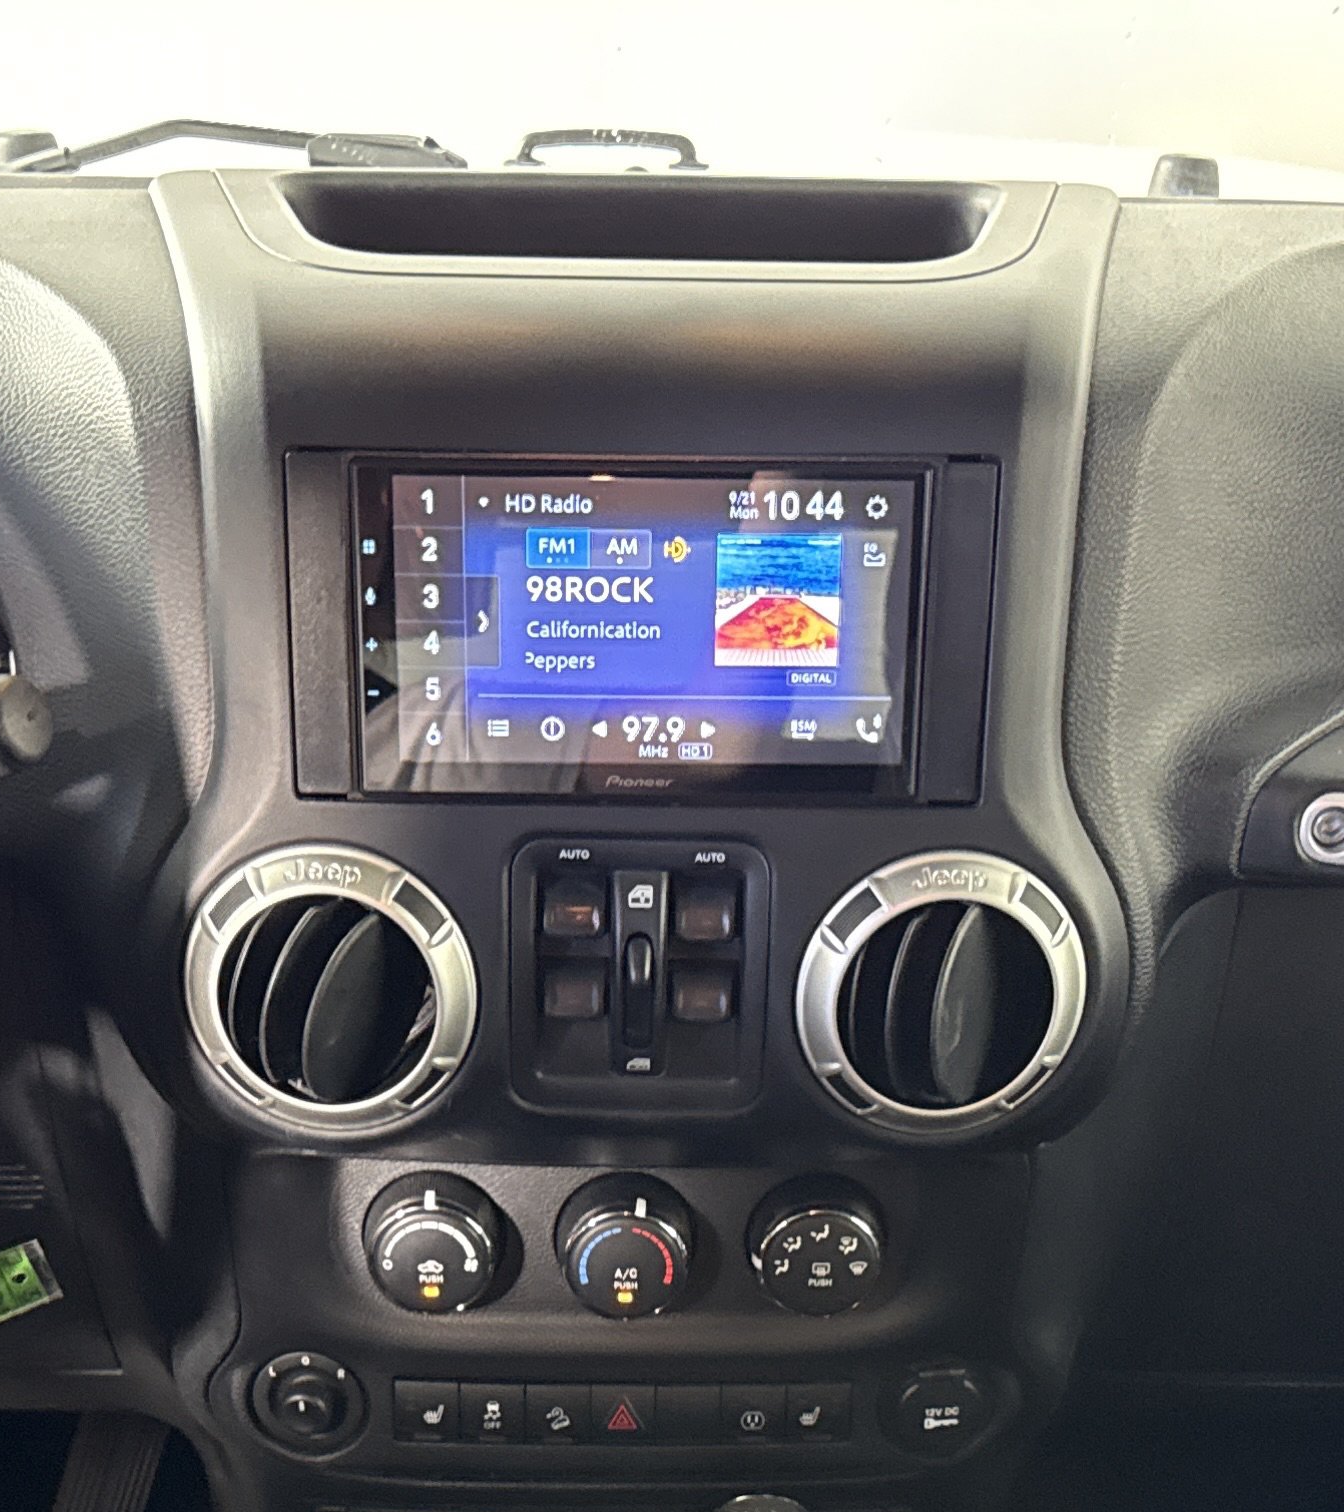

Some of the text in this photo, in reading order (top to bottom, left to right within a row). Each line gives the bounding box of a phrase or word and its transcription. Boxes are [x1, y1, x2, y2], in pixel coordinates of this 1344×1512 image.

[420, 489, 434, 515] 1
[505, 493, 593, 514] HD Radio
[729, 506, 759, 519] Mon
[421, 536, 438, 562] 2
[538, 537, 638, 555] FM1 AM
[422, 583, 440, 609] 3
[526, 576, 654, 603] 98ROCK
[526, 620, 661, 641] Californication
[423, 630, 440, 655] 4
[425, 677, 442, 701] 5
[790, 672, 832, 684] DIGITAL
[425, 722, 442, 746] 6
[622, 715, 686, 743] 97.9
[638, 744, 669, 758] MHz
[605, 775, 674, 788] Pioneer
[558, 849, 590, 860] AUTO
[694, 852, 726, 863] AUTO
[283, 858, 362, 888] Jeep
[912, 866, 988, 893] Jeep
[808, 1278, 833, 1287] PUSH
